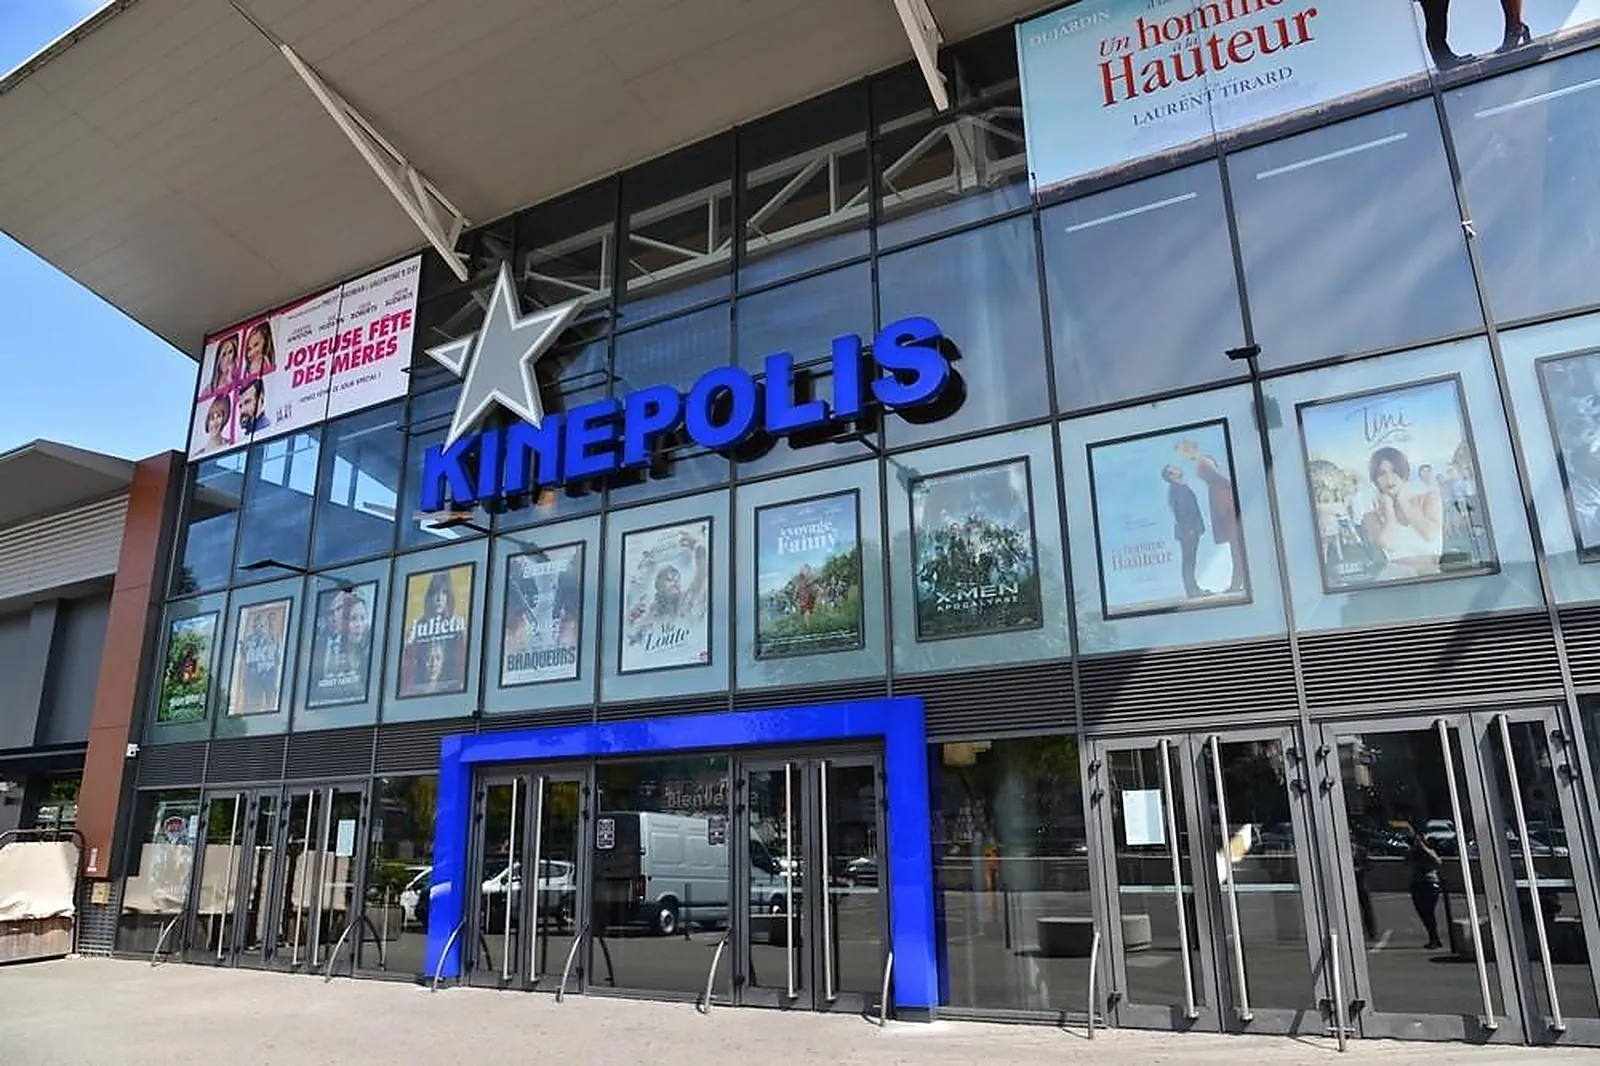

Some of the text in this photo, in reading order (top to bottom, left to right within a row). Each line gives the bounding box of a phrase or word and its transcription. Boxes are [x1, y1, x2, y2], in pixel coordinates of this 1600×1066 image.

[1030, 9, 1109, 47] DUJARDIN
[1099, 0, 1284, 58] Un homm
[1097, 7, 1318, 108] Hauteur
[1133, 66, 1293, 126] LAURENT TIRARD
[284, 327, 363, 371] JOYEUSE
[369, 308, 413, 341] FÊTE
[291, 361, 326, 389] DES
[420, 315, 954, 513] KINEPOLIS
[936, 582, 1019, 604] X-MEN
[507, 646, 576, 672] BRAQUEURS
